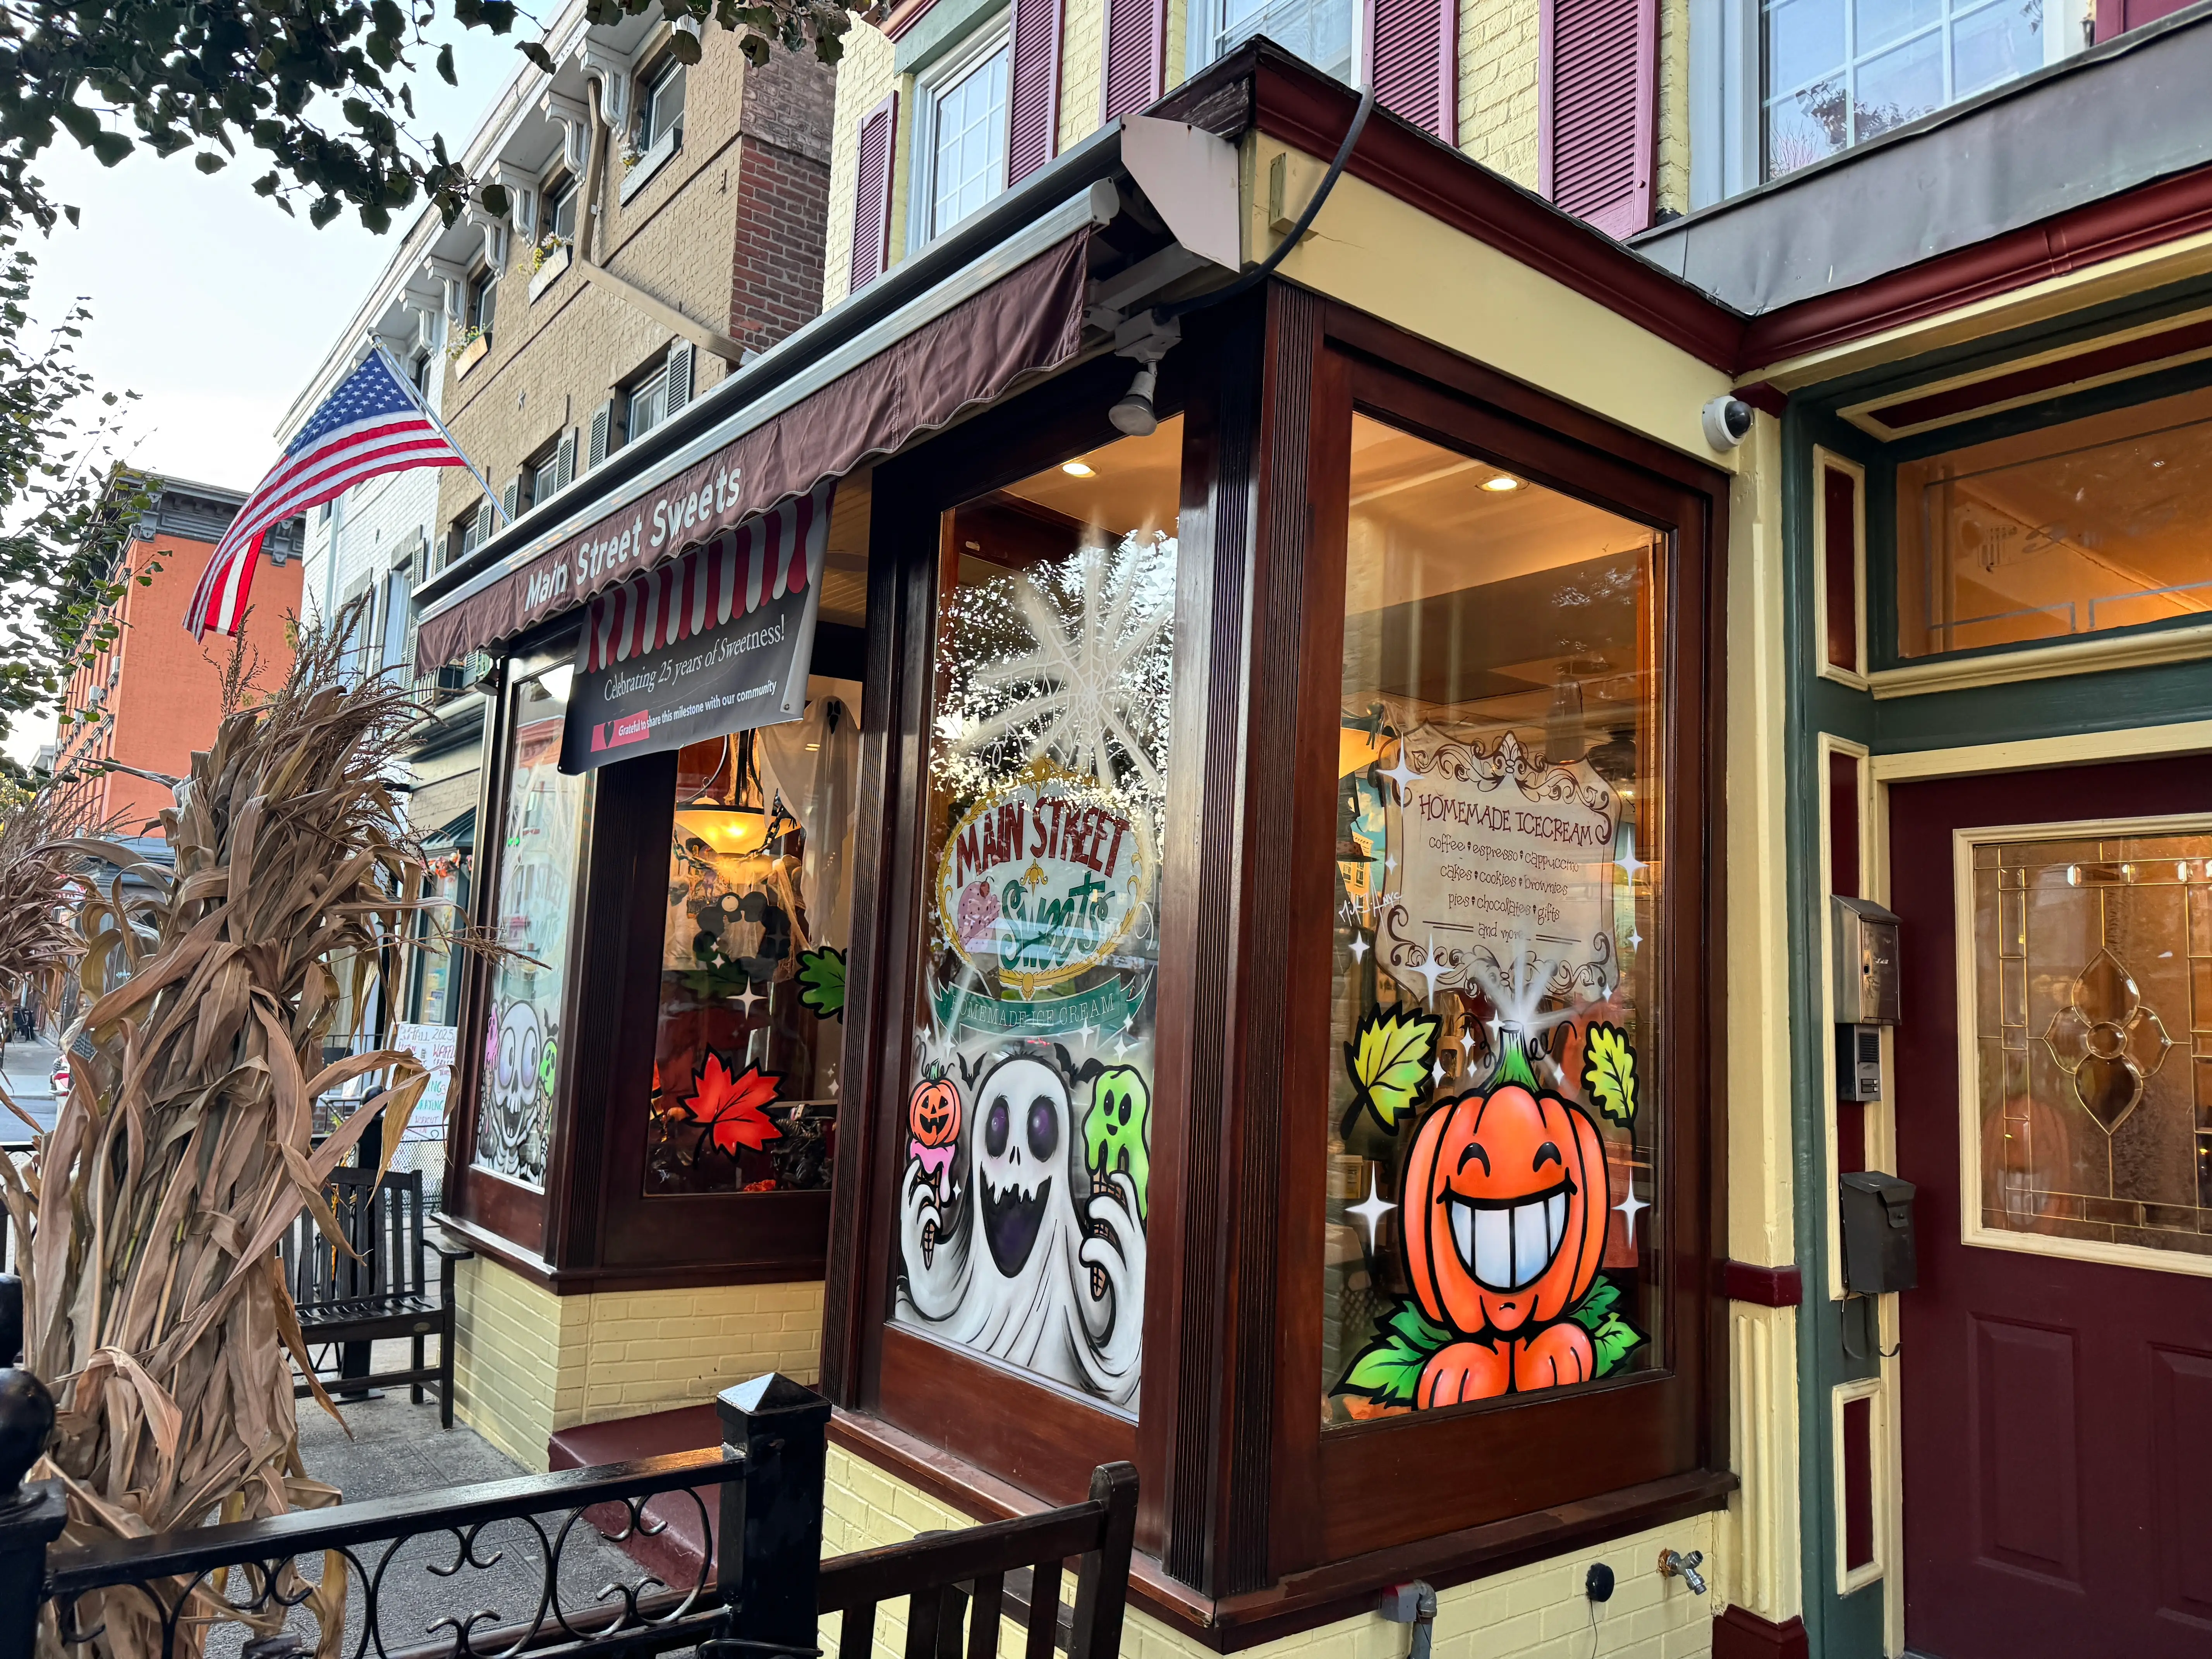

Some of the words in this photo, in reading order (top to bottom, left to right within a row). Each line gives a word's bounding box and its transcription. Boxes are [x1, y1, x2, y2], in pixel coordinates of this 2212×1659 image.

[525, 560, 568, 612] Main
[576, 514, 642, 586] Street
[650, 465, 741, 547] Sweets
[604, 666, 657, 701] Celebrating
[658, 659, 672, 683] 25
[672, 655, 702, 685] years
[704, 639, 720, 667] of
[718, 613, 785, 662] Sweetness!
[618, 719, 640, 736] Grateful
[641, 720, 646, 730] to
[647, 716, 661, 728] share
[661, 709, 672, 723] this
[673, 703, 704, 720] milestone
[705, 695, 720, 711] with
[722, 694, 735, 706] our
[737, 679, 777, 702] community
[956, 800, 1024, 889] MAIN
[1030, 796, 1131, 878] STREET
[1419, 793, 1511, 832] HOMEMADE
[1515, 812, 1593, 847] ICECREAM
[1429, 833, 1465, 853] coffee
[1473, 843, 1518, 860] espresso
[1525, 851, 1580, 872] cappuccino
[1440, 864, 1472, 881] cakes
[1479, 871, 1516, 887] cookies
[1524, 874, 1568, 896] brownies
[1000, 870, 1115, 971] Sweets
[1448, 893, 1470, 909] pies
[1477, 894, 1531, 917] chocolates
[1537, 903, 1560, 926] gifts
[1478, 922, 1498, 939] and
[409, 1025, 429, 1041] FALL
[1031, 1009, 1054, 1028] ICE
[1060, 993, 1115, 1025] CREAM
